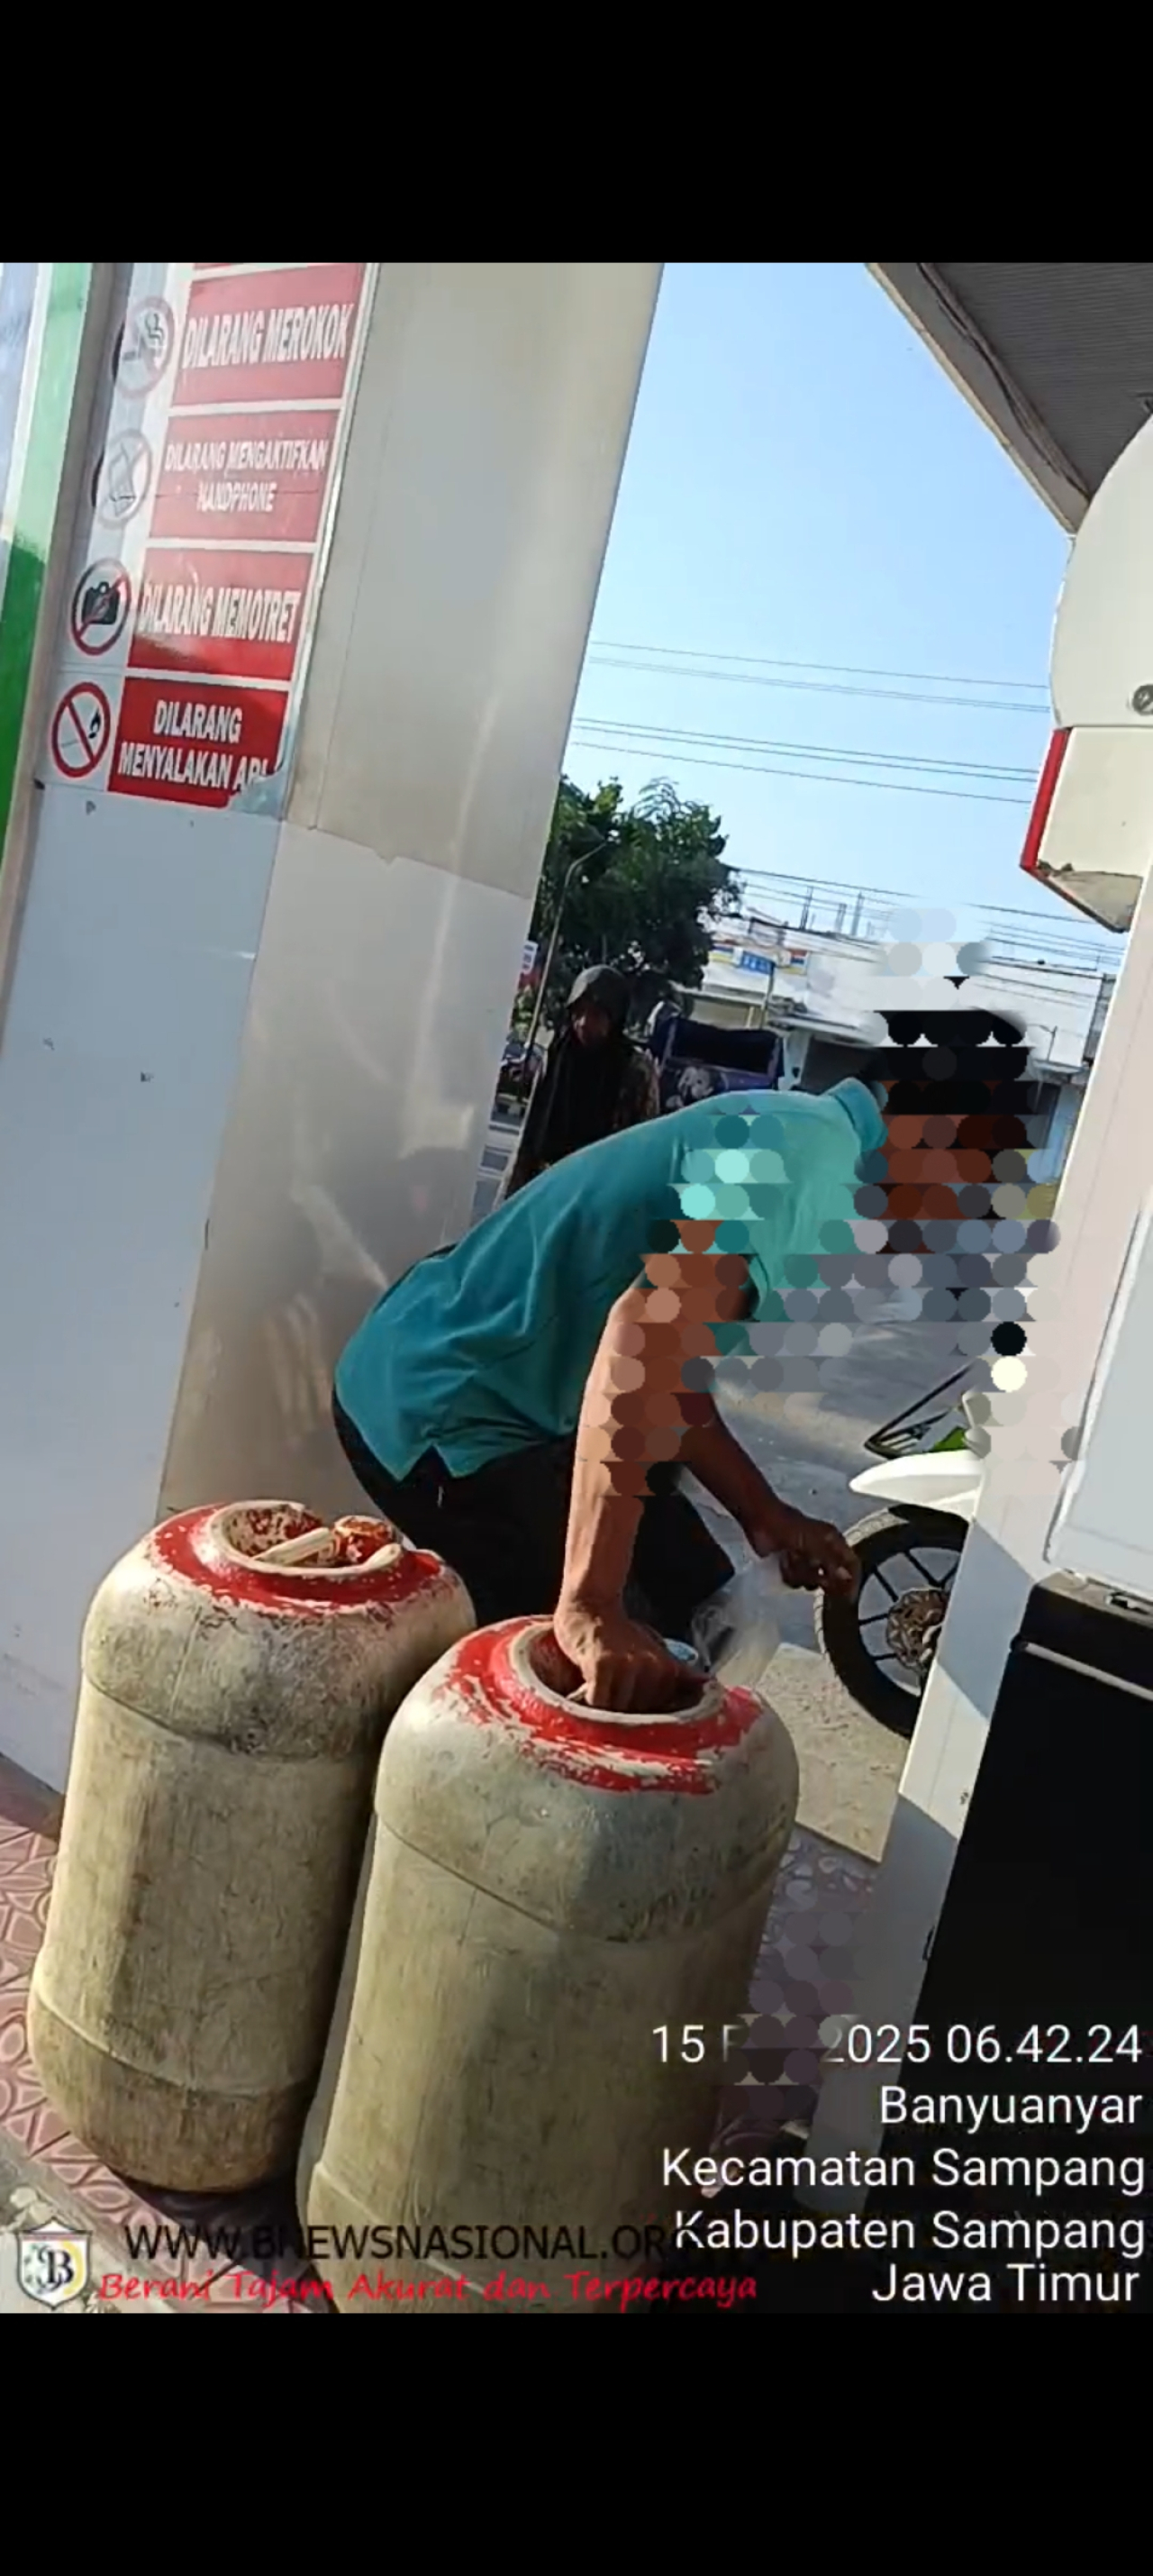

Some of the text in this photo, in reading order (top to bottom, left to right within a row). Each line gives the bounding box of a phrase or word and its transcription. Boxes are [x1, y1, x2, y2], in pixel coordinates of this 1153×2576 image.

[181, 303, 354, 369] DILARANG MEROKOK
[164, 439, 330, 472] DILARANG MENGAKTIFKAN
[137, 582, 303, 643] DILARANG MEMOTRET
[152, 699, 243, 744] DILARANG
[117, 741, 233, 790] MENYALAKAN
